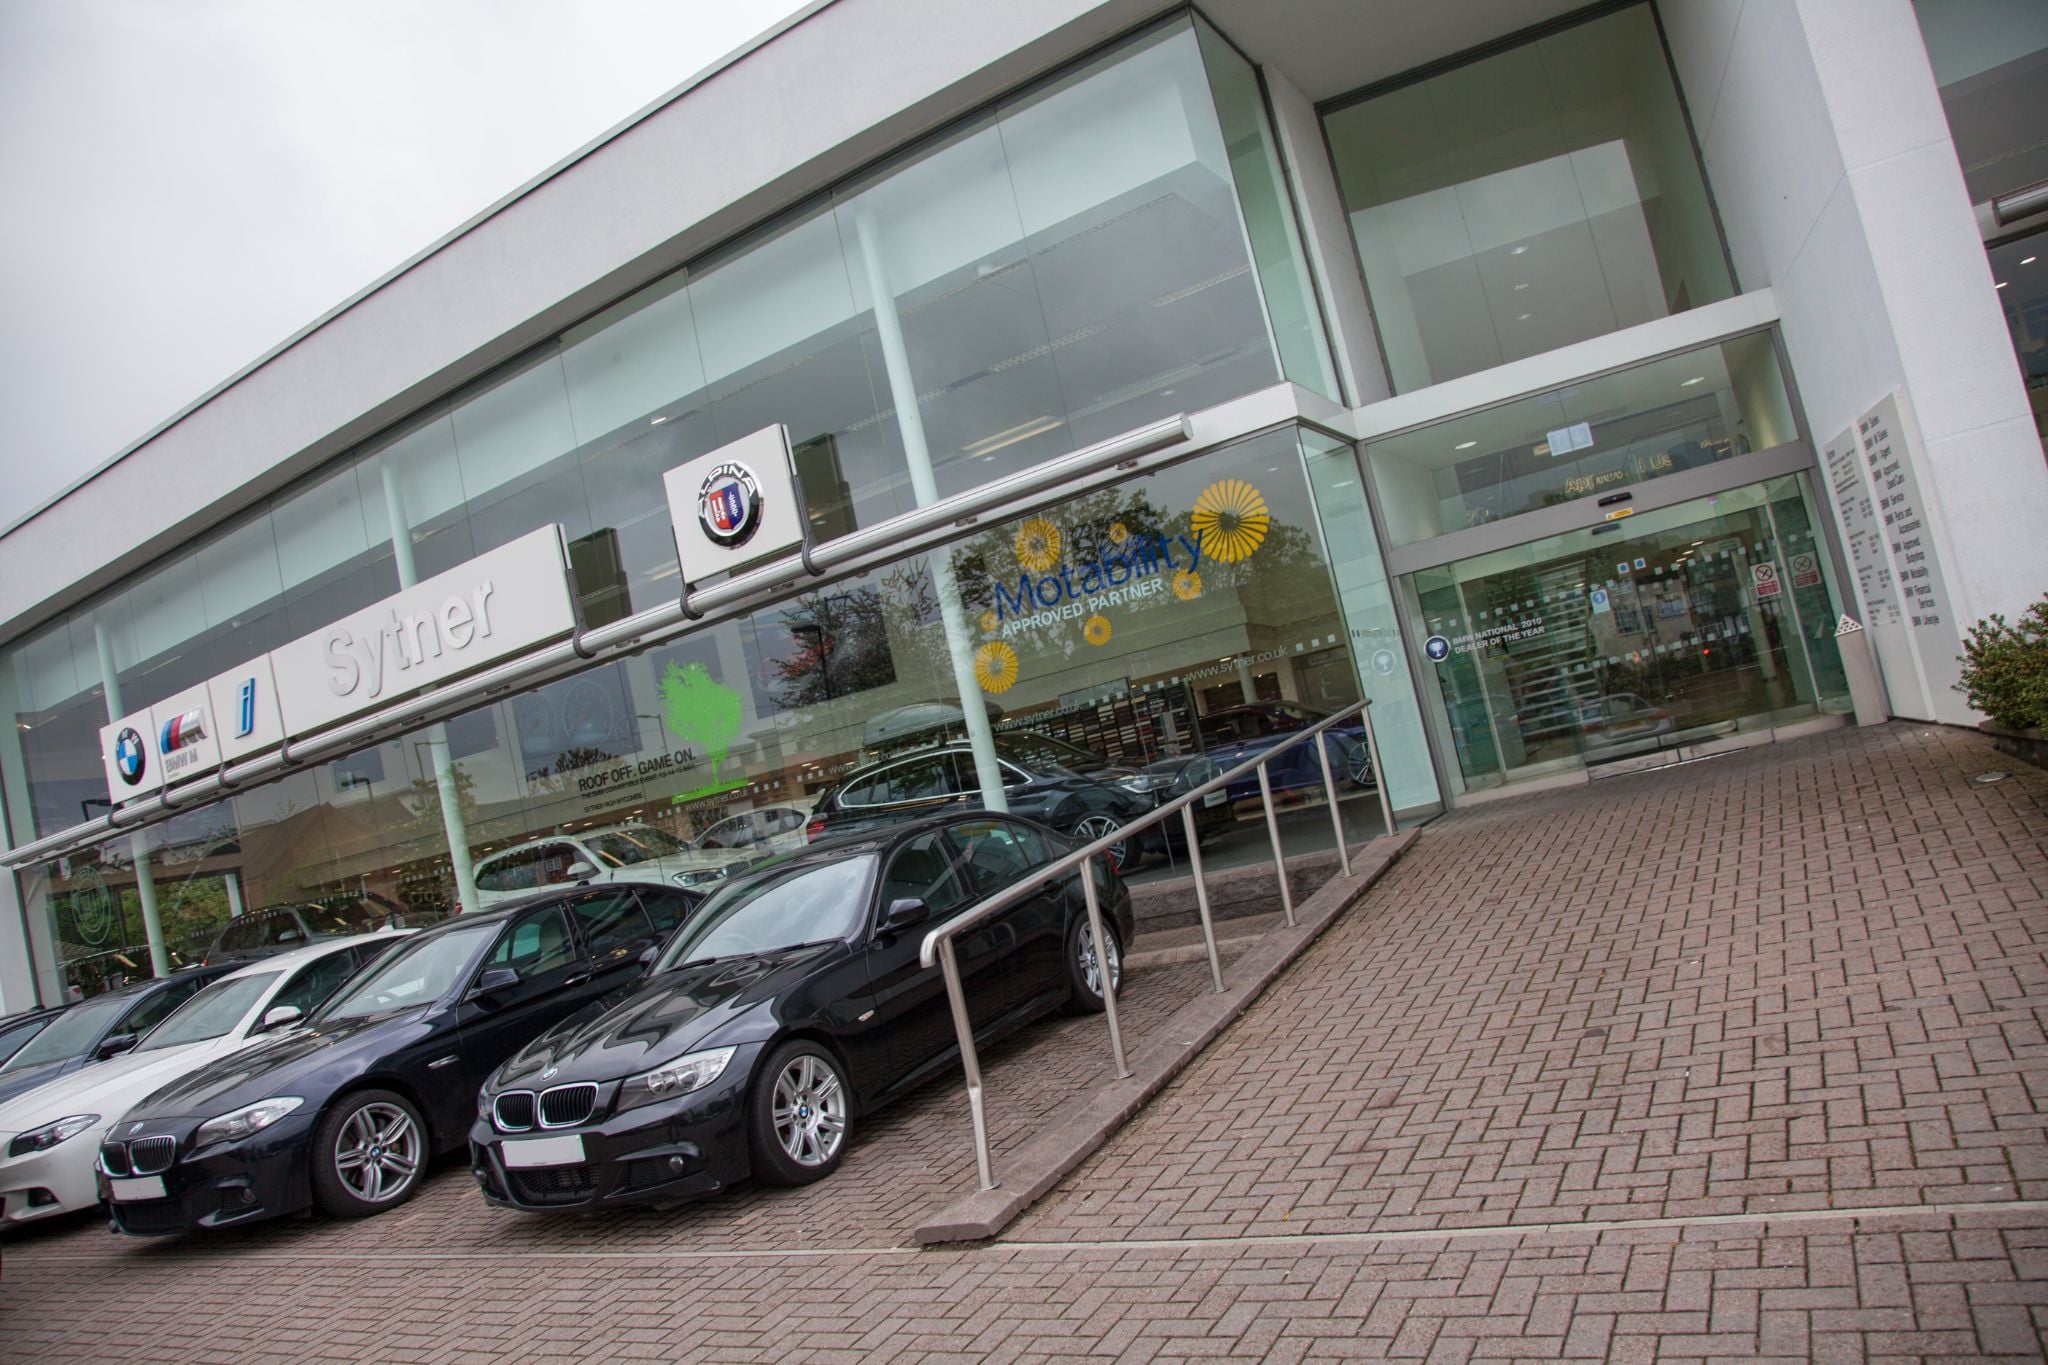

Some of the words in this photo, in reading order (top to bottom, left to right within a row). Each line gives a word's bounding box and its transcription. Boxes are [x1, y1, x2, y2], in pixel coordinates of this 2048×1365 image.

[698, 463, 757, 519] ALPINA
[994, 528, 1203, 621] Motability
[1002, 603, 1083, 638] APPROVED
[1088, 577, 1164, 612] PARTNER
[324, 580, 494, 698] Sytner
[1452, 631, 1474, 645] BMW
[1474, 622, 1519, 639] NATIONAL
[1520, 617, 1542, 630] 2010
[1454, 639, 1490, 654] DEALER
[1490, 637, 1502, 649] OF
[1503, 631, 1522, 645] THE
[1522, 625, 1545, 639] YEAR
[1185, 645, 1288, 682] www.sytner.co.uk
[993, 699, 1080, 732] www.sytner.co.uk
[578, 772, 609, 792] ROOF
[611, 764, 637, 783] OFF.
[638, 753, 674, 775] GAME
[674, 748, 696, 764] ON.
